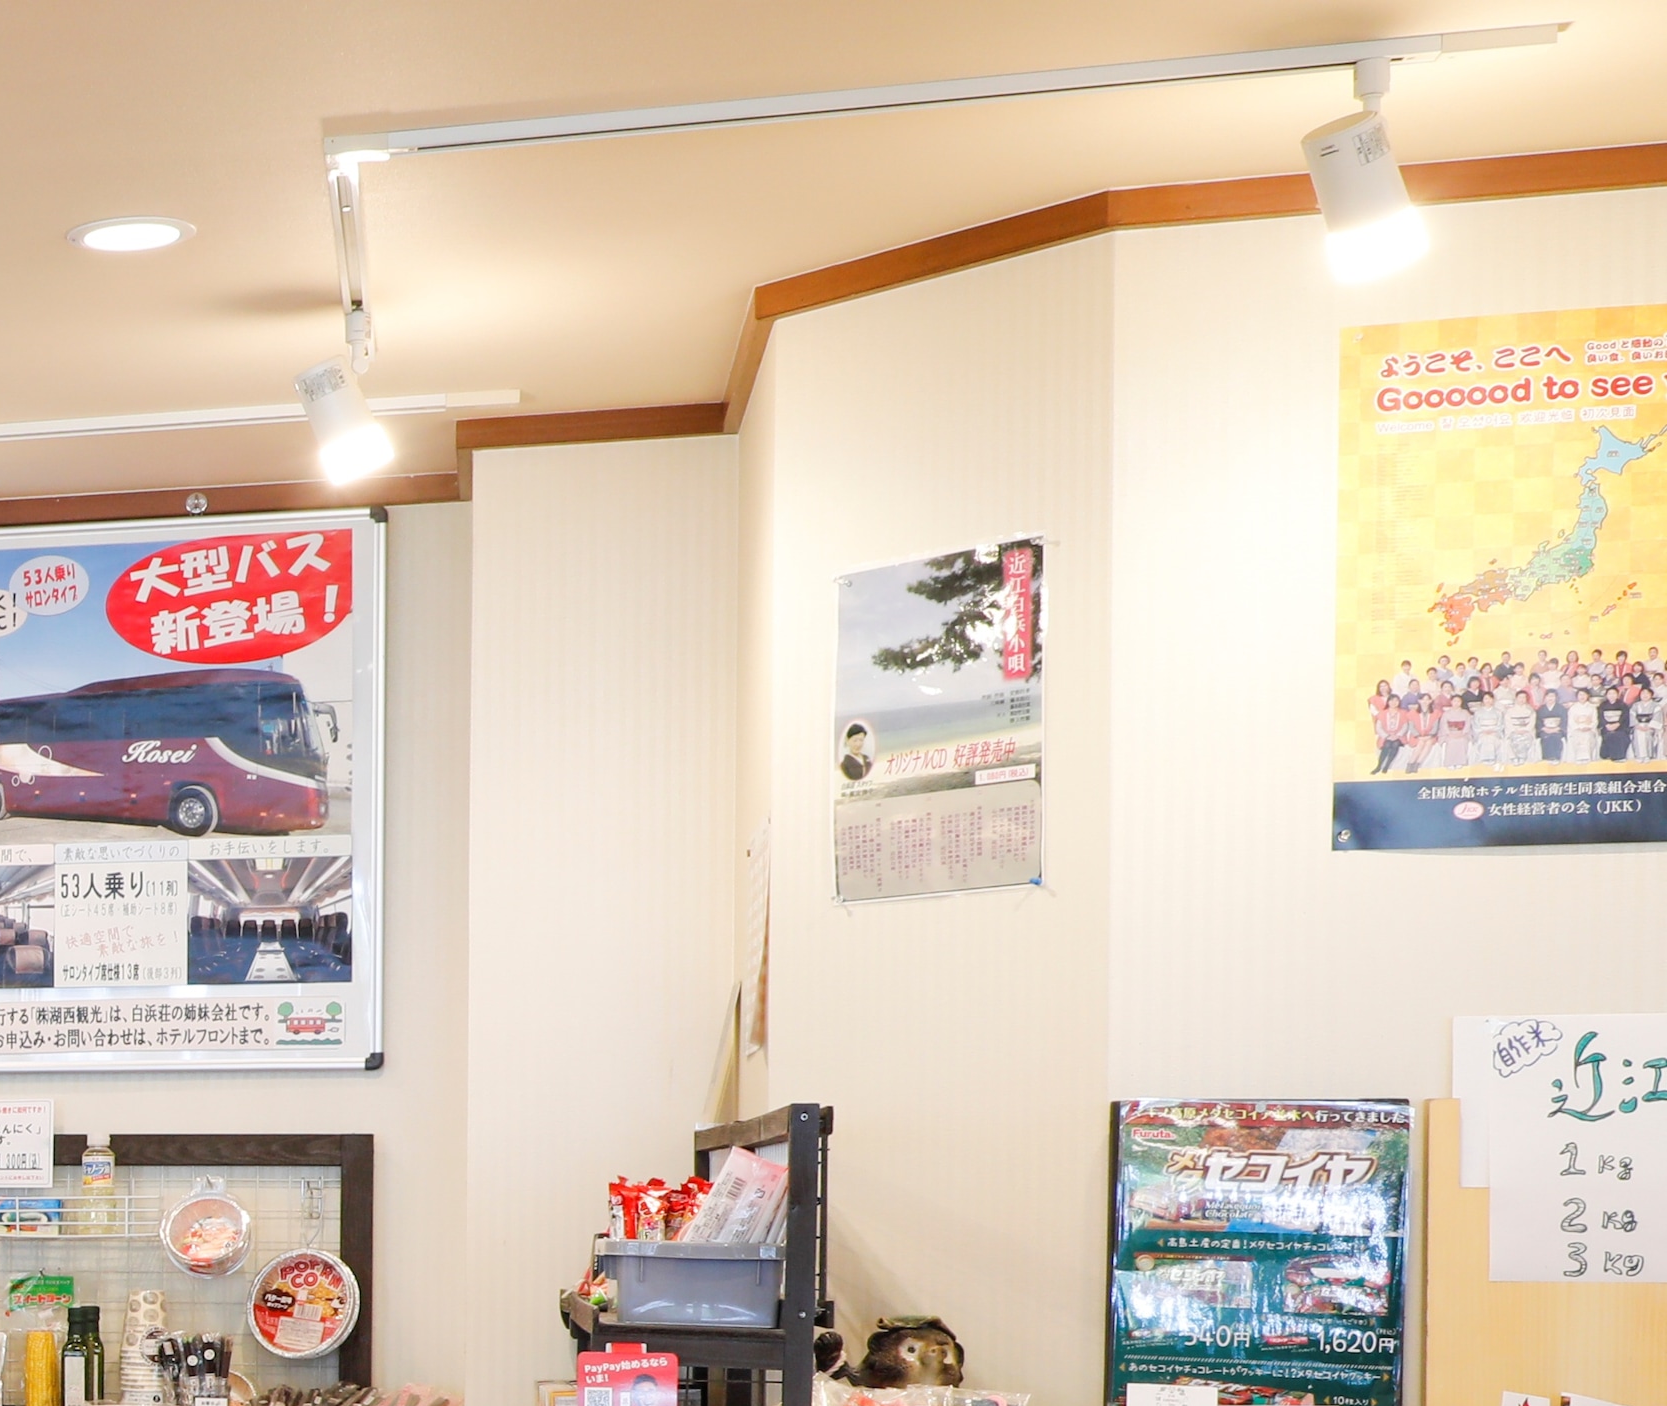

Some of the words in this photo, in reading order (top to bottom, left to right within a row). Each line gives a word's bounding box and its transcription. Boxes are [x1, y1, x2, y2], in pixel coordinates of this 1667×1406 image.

[1379, 345, 1572, 379] ようこそ、ここへ
[1376, 376, 1532, 412] Goooood
[1542, 375, 1580, 401] to
[1590, 375, 1654, 397] see
[1376, 419, 1433, 433] Welcome
[23, 565, 77, 588] 53人乗り
[129, 531, 333, 604] 大型バス
[24, 586, 79, 609] サロンタイプ
[150, 584, 339, 655] 新登場！
[121, 740, 199, 765] Kosei
[884, 748, 948, 776] オリジナルCD
[951, 736, 1017, 768] 好評発売中
[1487, 798, 1643, 817] 女性経営者の会（JKK）
[63, 845, 180, 862] 素敵な思いでづくりの
[208, 838, 332, 856] お手伝いをします。
[66, 924, 135, 950] 快適空間で
[1496, 1024, 1548, 1068] 自作米
[1547, 1031, 1667, 1122] 近江
[1132, 1128, 1175, 1140] Furuta
[1559, 1142, 1587, 1177] 1
[1560, 1197, 1588, 1234] 2
[1563, 1242, 1588, 1277] 3
[1317, 1329, 1395, 1355] 1,620円
[584, 1356, 669, 1374] PayPay始めるなら
[585, 1373, 610, 1384] いま！
